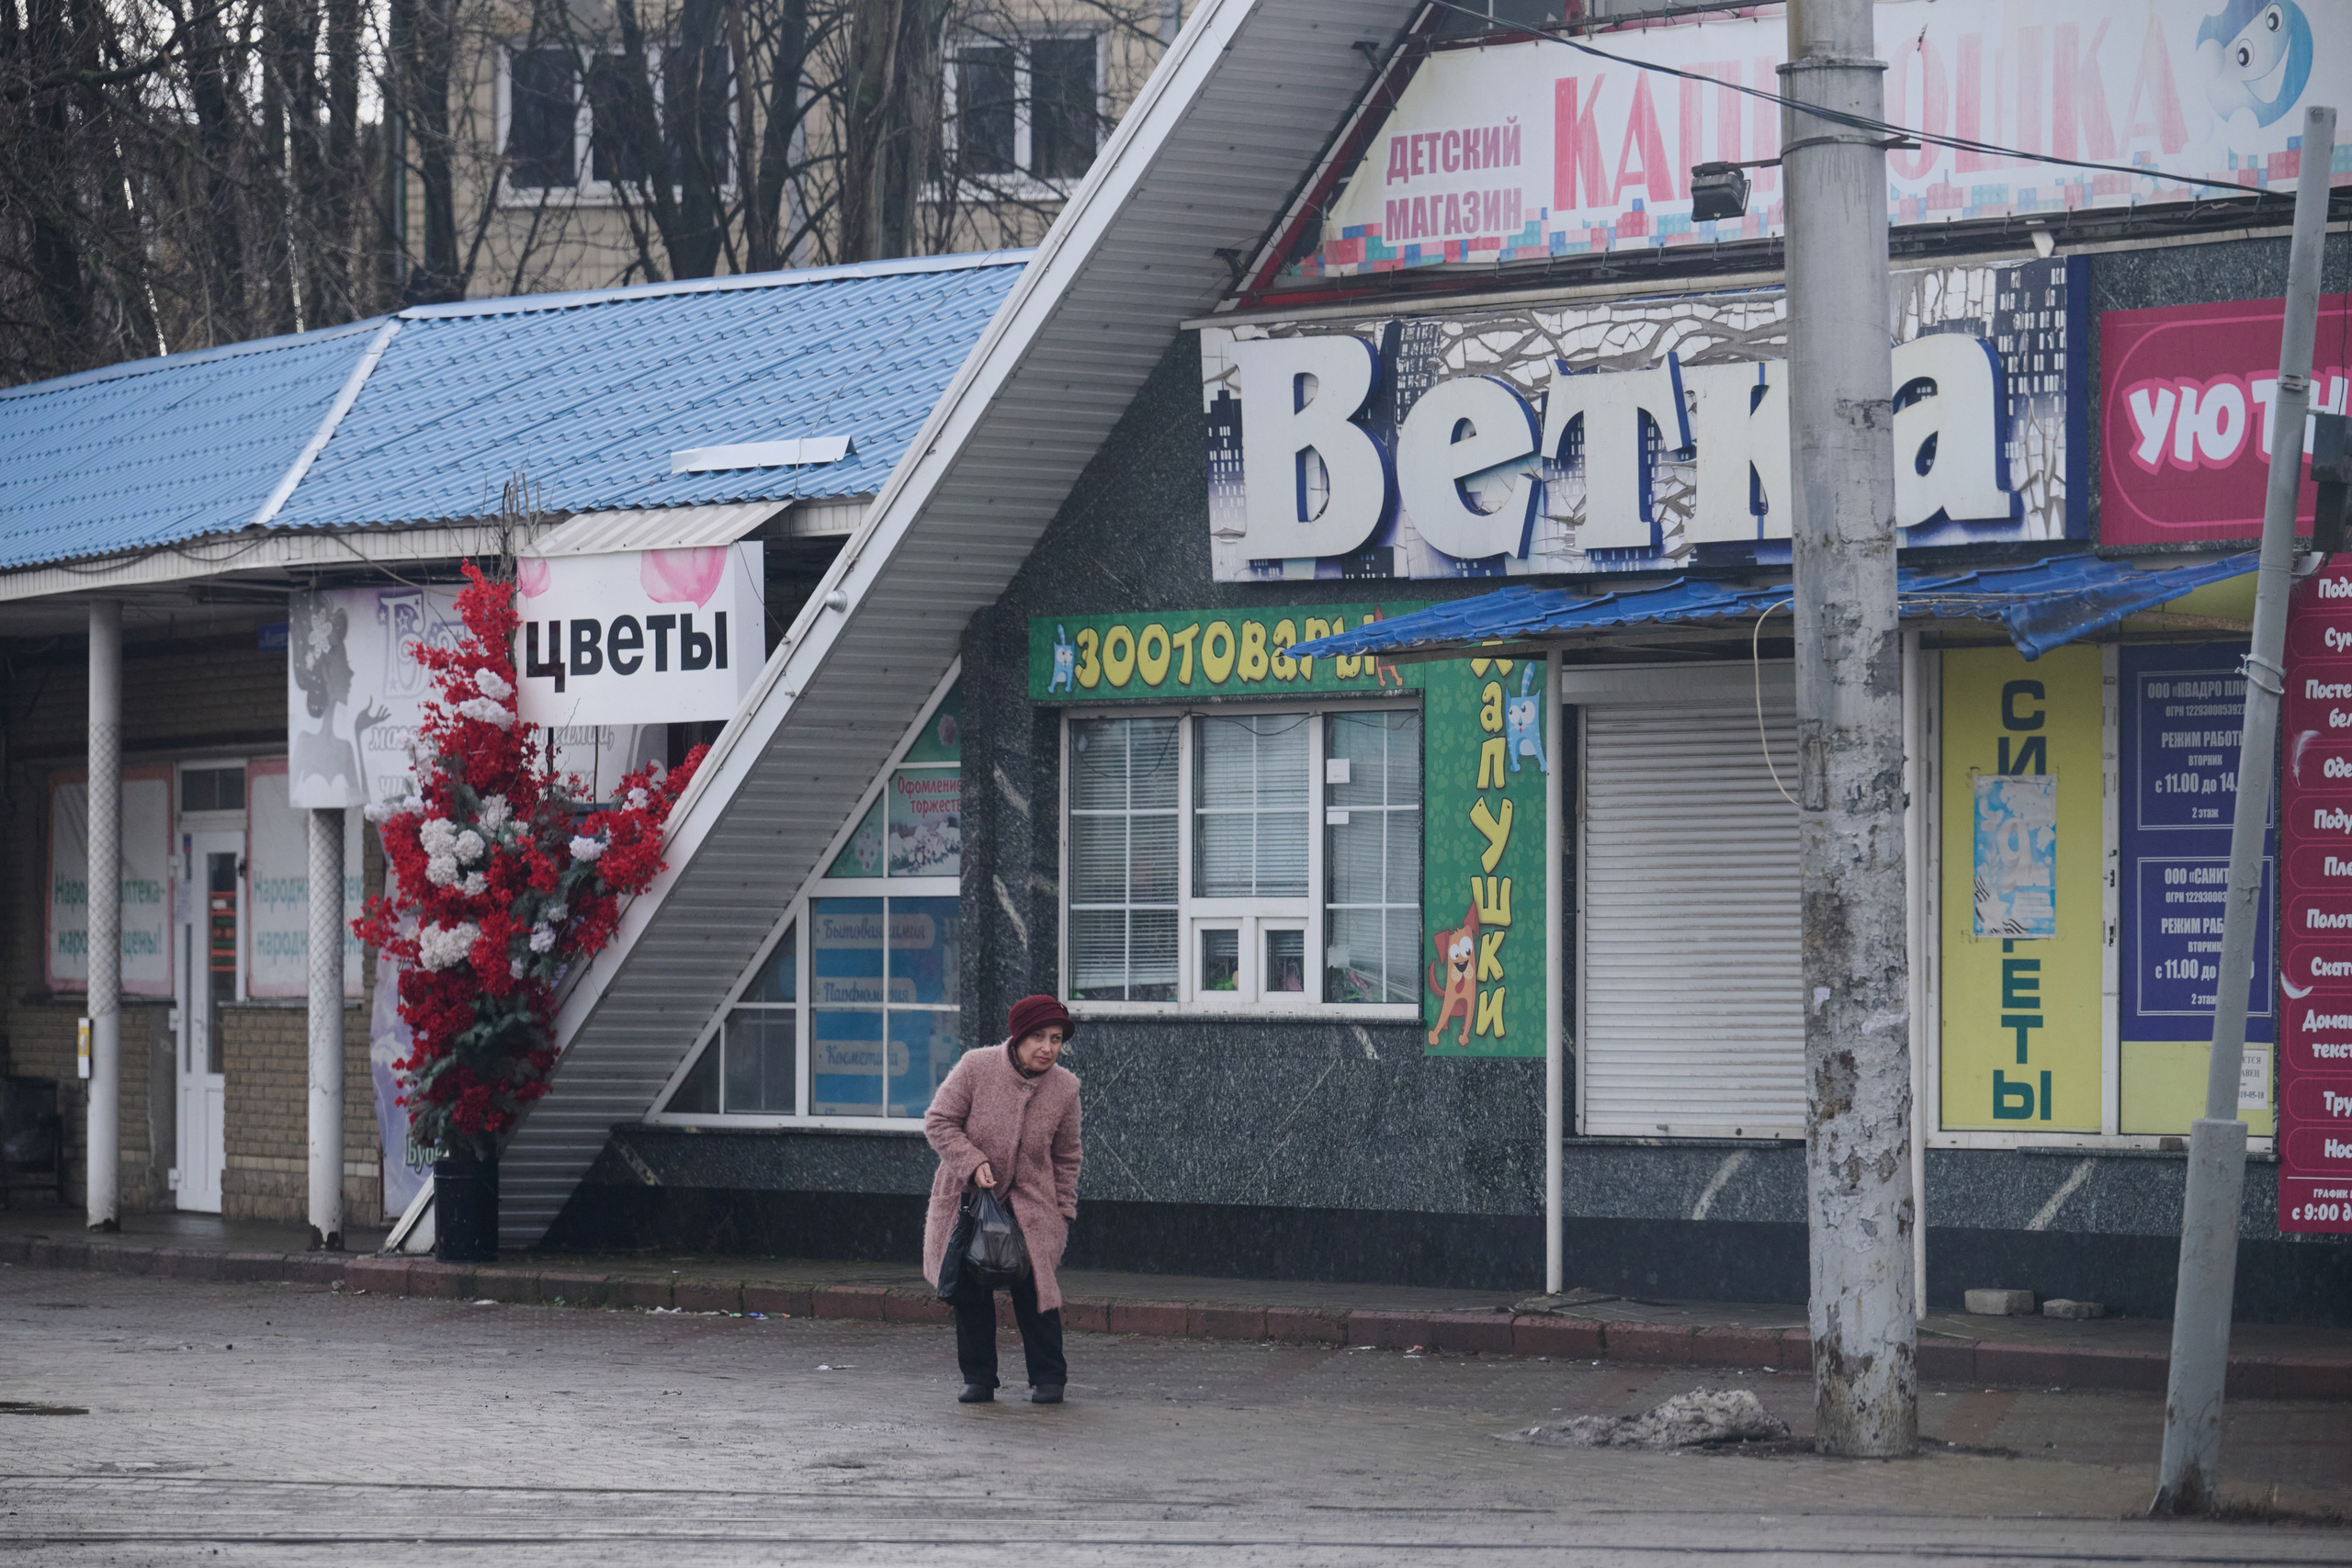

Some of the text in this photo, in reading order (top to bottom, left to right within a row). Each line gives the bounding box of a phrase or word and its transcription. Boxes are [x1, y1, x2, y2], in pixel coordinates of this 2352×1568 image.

[1554, 13, 2190, 211] КАПОШКА
[1386, 115, 1521, 186] ДЕТСКИЙ
[1385, 186, 1521, 242] МАГАЗИН
[1228, 333, 2012, 559] Ветка
[526, 611, 729, 693] цветы
[2147, 682, 2170, 699] ООО
[2165, 705, 2185, 717] ОГРН
[2161, 732, 2201, 748] РЕЖИМ
[2188, 754, 2222, 766] ВТОРНИК
[2154, 773, 2238, 795] с 11.00 до 14.
[2191, 807, 2219, 818] 2 этаж
[2165, 867, 2230, 885] ООО «САНИТ
[1993, 680, 2052, 1121] СИЕТЫ
[2165, 892, 2185, 903] ОГРН
[2161, 918, 2224, 934] РЕЖИМ РАБ
[2188, 942, 2222, 953] ВТОРНИК
[2154, 965, 2162, 979] с
[2165, 959, 2199, 979] 11.00
[2201, 965, 2217, 981] до
[2191, 993, 2197, 1004] 2
[2313, 1189, 2348, 1199] ГРАФИК
[2291, 1207, 2301, 1221] с
[2304, 1203, 2339, 1221] 9:00
